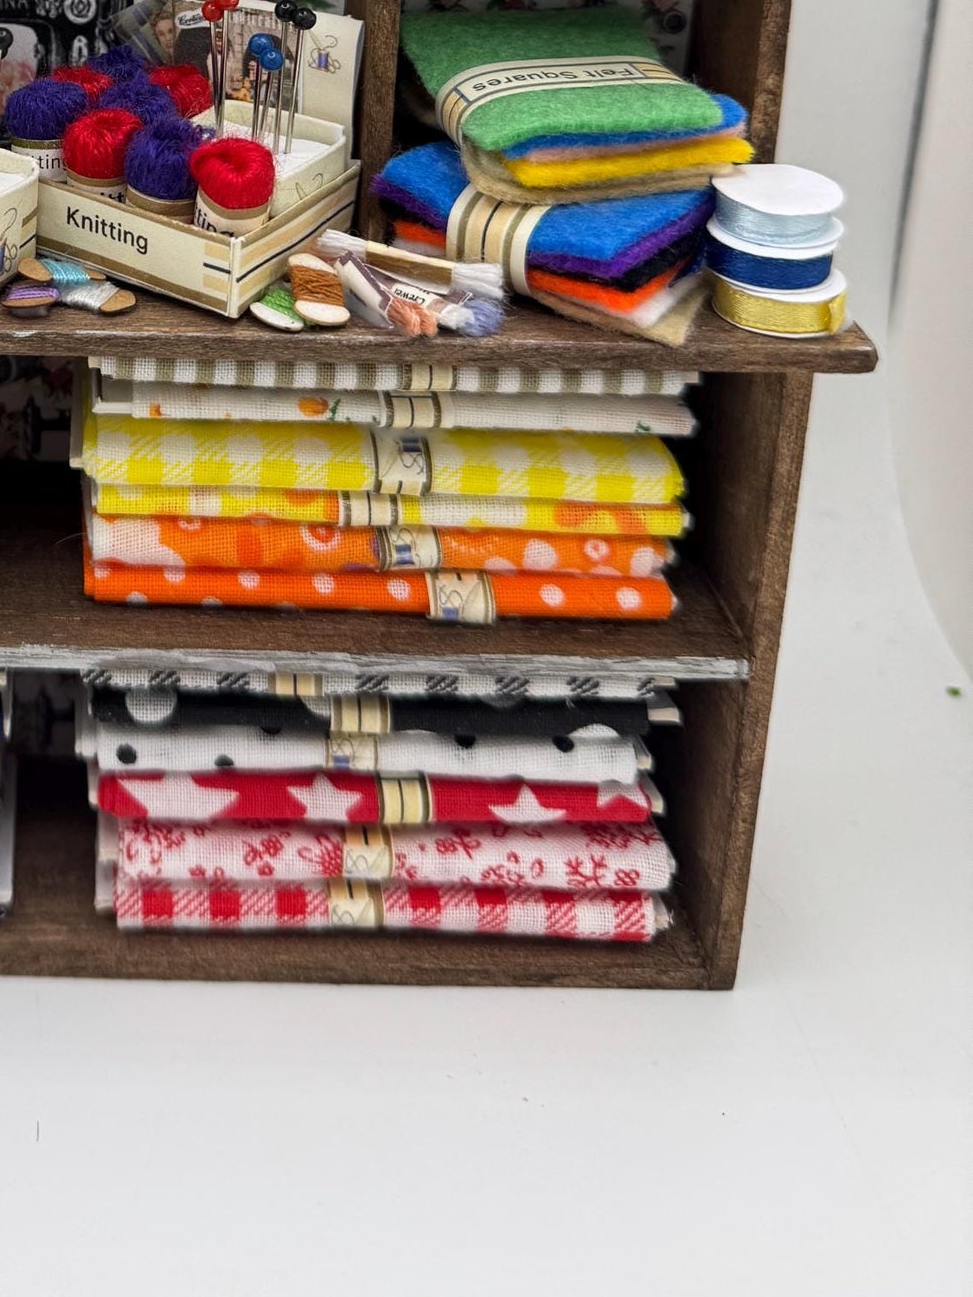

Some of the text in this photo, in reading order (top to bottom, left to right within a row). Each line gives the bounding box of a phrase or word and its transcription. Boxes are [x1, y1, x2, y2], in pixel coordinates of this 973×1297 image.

[472, 67, 634, 92] Felt Squares
[66, 205, 149, 256] Knitting
